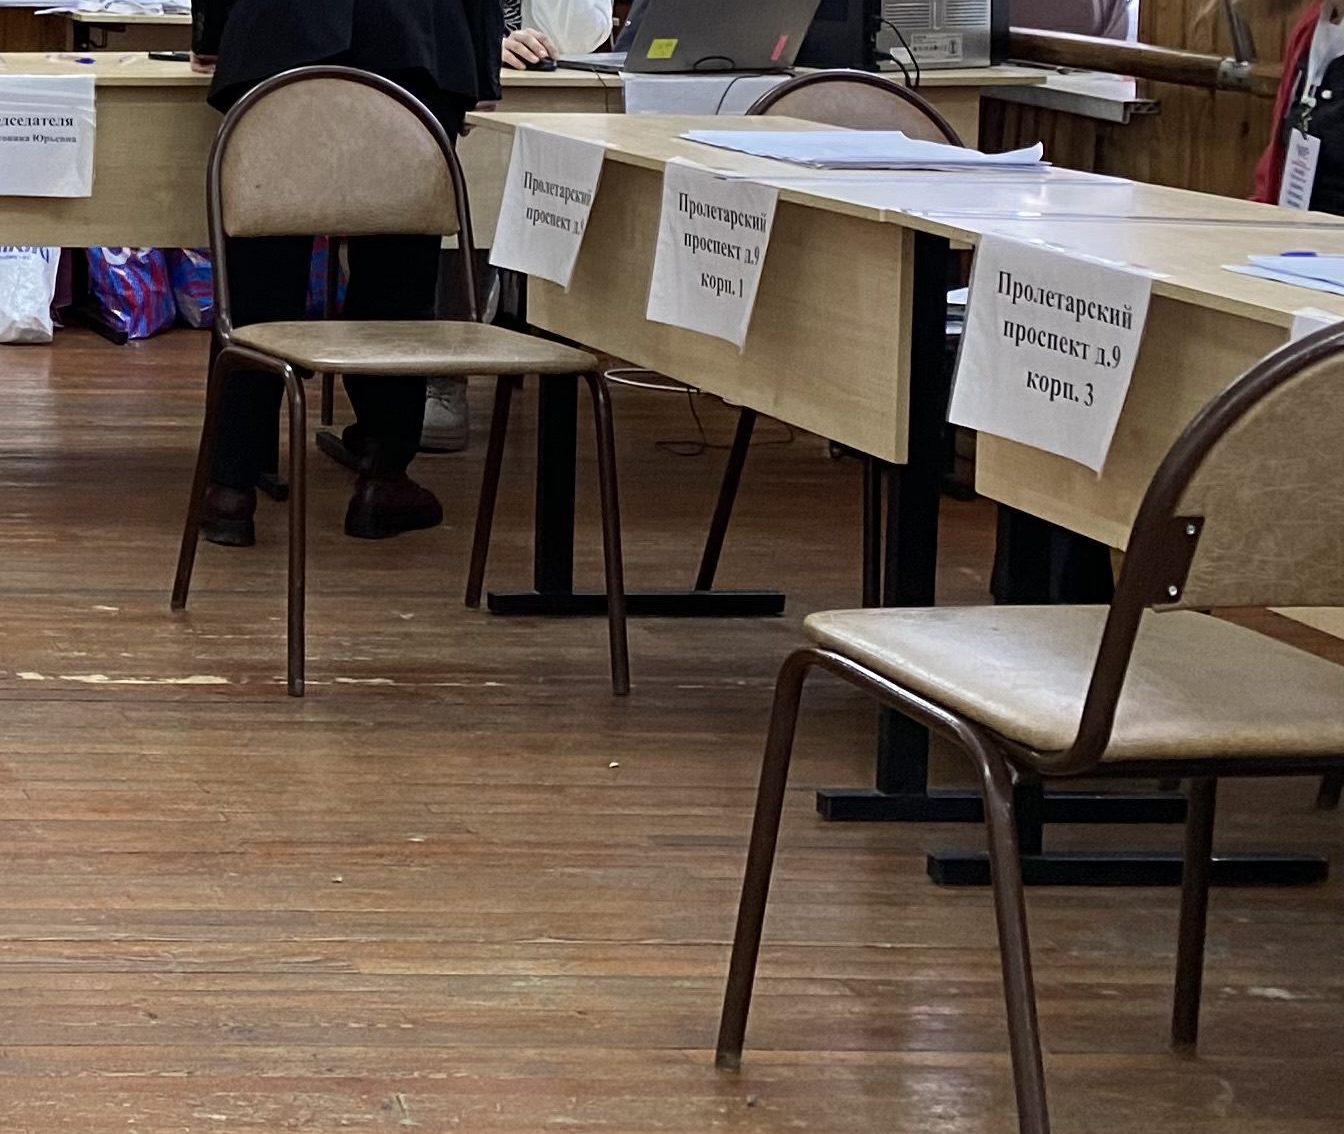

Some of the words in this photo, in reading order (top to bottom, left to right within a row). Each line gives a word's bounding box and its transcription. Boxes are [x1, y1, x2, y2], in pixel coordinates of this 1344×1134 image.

[32, 134, 77, 144] Юрьевна
[524, 171, 592, 206] Пролетарский
[526, 207, 571, 231] проспект
[679, 192, 767, 232] Пролетарский
[684, 233, 741, 260] проспект
[744, 246, 760, 265] д.9
[701, 273, 735, 296] корп.
[739, 278, 743, 298] 1
[997, 270, 1133, 330] Пролетарский
[1003, 320, 1090, 360] проспект
[1095, 345, 1121, 369] д.9
[1026, 371, 1079, 402] корп.
[1084, 382, 1094, 407] 3
